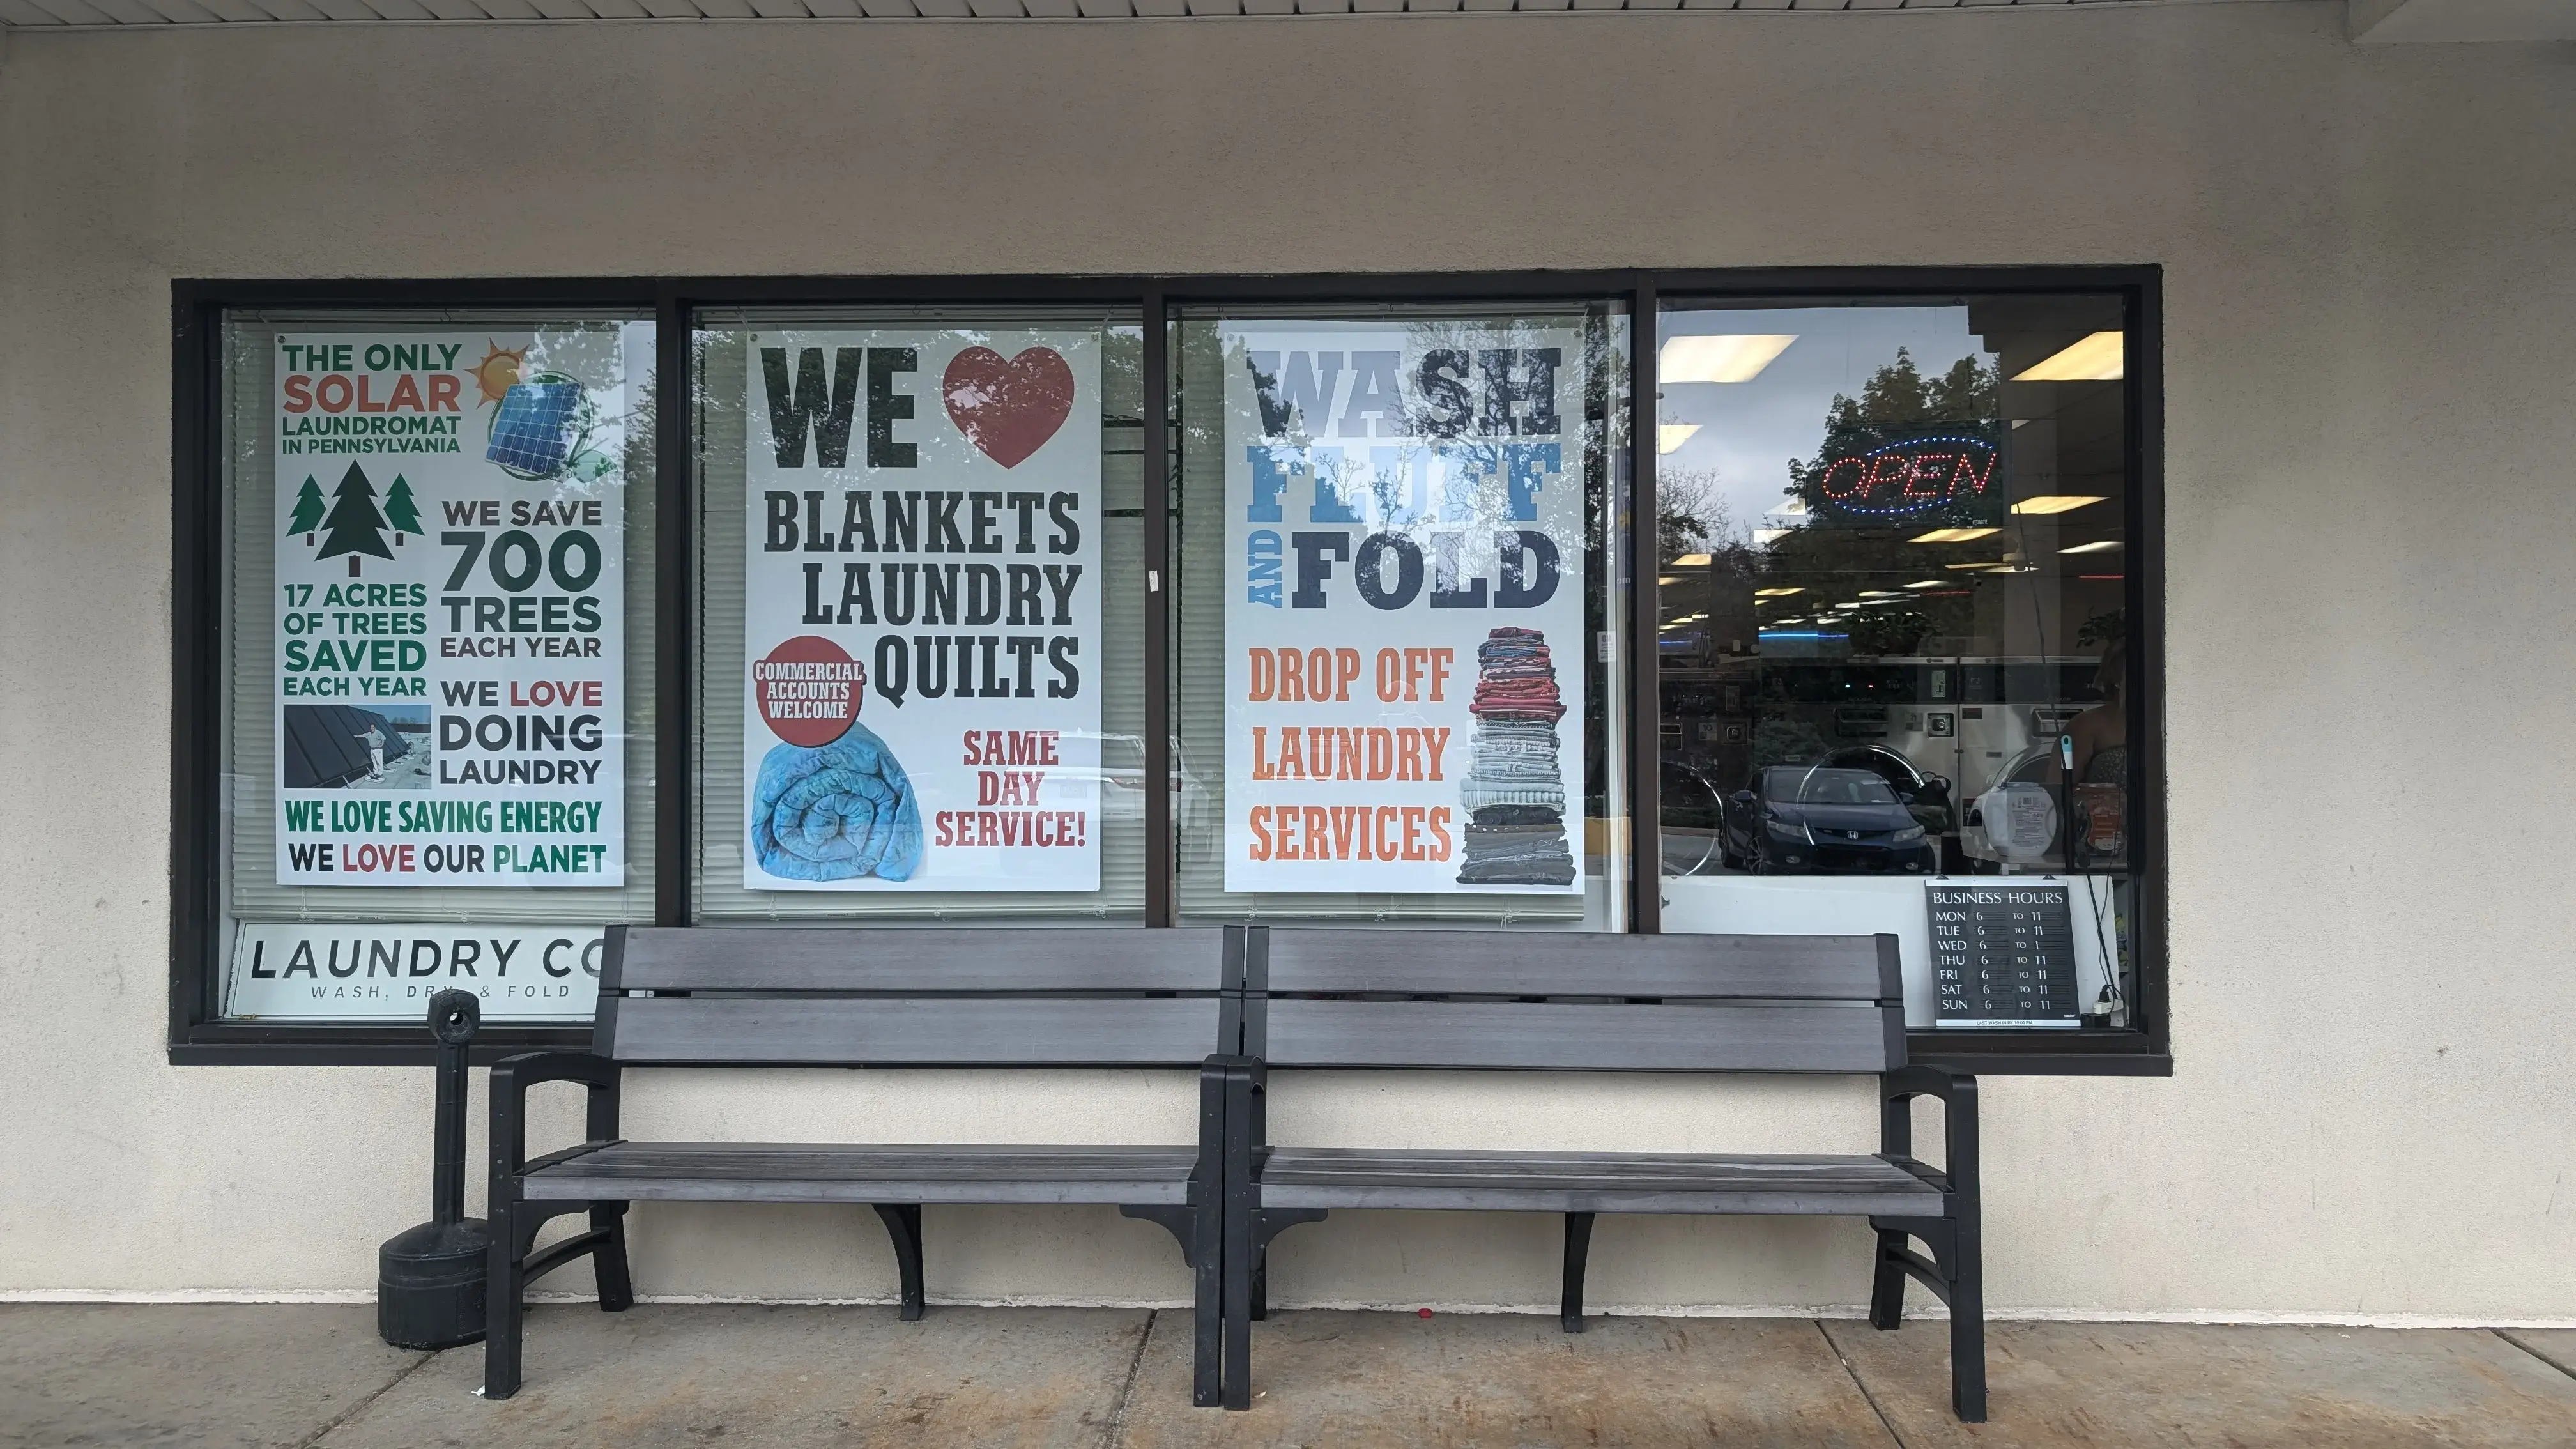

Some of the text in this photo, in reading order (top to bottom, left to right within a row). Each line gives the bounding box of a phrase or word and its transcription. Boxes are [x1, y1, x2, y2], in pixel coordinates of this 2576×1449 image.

[282, 344, 462, 371] THE ONLY
[284, 374, 461, 413] SOLAR
[760, 347, 918, 468] WE
[1246, 348, 1561, 439] WASH
[282, 416, 461, 436] LAUNDROMAT
[282, 438, 461, 454] IN PENNSYLVANIA
[1247, 443, 1561, 523] FLUFF
[1822, 452, 1998, 500] OPEN
[441, 500, 602, 526] WE SAVE
[764, 491, 1080, 555] BLANKETS
[441, 530, 602, 592] 700
[1248, 530, 1282, 608] AND
[1292, 530, 1561, 610] FOLD
[284, 583, 427, 608] 17 ACRES
[802, 563, 1082, 626] LAUNDRY
[284, 612, 427, 635] OF TREES
[441, 595, 602, 633] TREES
[284, 640, 427, 672] SAVED
[440, 637, 602, 658] EACH YEAR
[284, 677, 427, 696] EACH YEAR
[755, 662, 862, 682] COMMERCIAL
[874, 634, 1080, 709] QUILTS
[1248, 647, 1454, 702] DROP OFF
[440, 680, 602, 707] WE LOVE
[766, 682, 850, 700] ACCOUNTS
[768, 701, 848, 719] WELCOME
[440, 714, 602, 752] DOING
[963, 730, 1059, 766] SAME
[1252, 726, 1450, 782] LAUNDRY
[440, 760, 602, 785] LAUNDRY
[977, 771, 1045, 806] DAY
[284, 800, 602, 833] WE LOVE SAVING ENERGY
[935, 811, 1086, 847] SERVICE!
[1250, 805, 1452, 862] SERVICES
[288, 843, 607, 873] WE LOVE OUR PLANET
[1933, 892, 2063, 904] BUSINESS HOURS
[1936, 912, 1966, 921] MON
[1976, 912, 1983, 921] 6
[2031, 912, 2041, 921] 11
[1936, 926, 1959, 936] TUE
[1977, 926, 1984, 935] 6
[2034, 926, 2043, 935] 11
[251, 939, 521, 978] LAUNDRY
[1938, 940, 1966, 951] WED
[1979, 941, 1986, 950] 6
[2035, 940, 2039, 950] 1
[1939, 955, 1965, 965] THU
[1981, 955, 1988, 965] 6
[2035, 955, 2046, 965] 11
[1940, 970, 1958, 980] FRI
[1982, 970, 1989, 979] 6
[2038, 970, 2046, 979] 11
[1941, 985, 1962, 995] SAT
[1983, 985, 1990, 994] 6
[2039, 985, 2048, 994] 11
[311, 986, 389, 1001] WASH,
[480, 985, 491, 997] &
[507, 985, 570, 997] FOLD
[1942, 999, 1968, 1009] SUN
[1985, 1000, 1992, 1009] 6
[2040, 1000, 2050, 1009] 11
